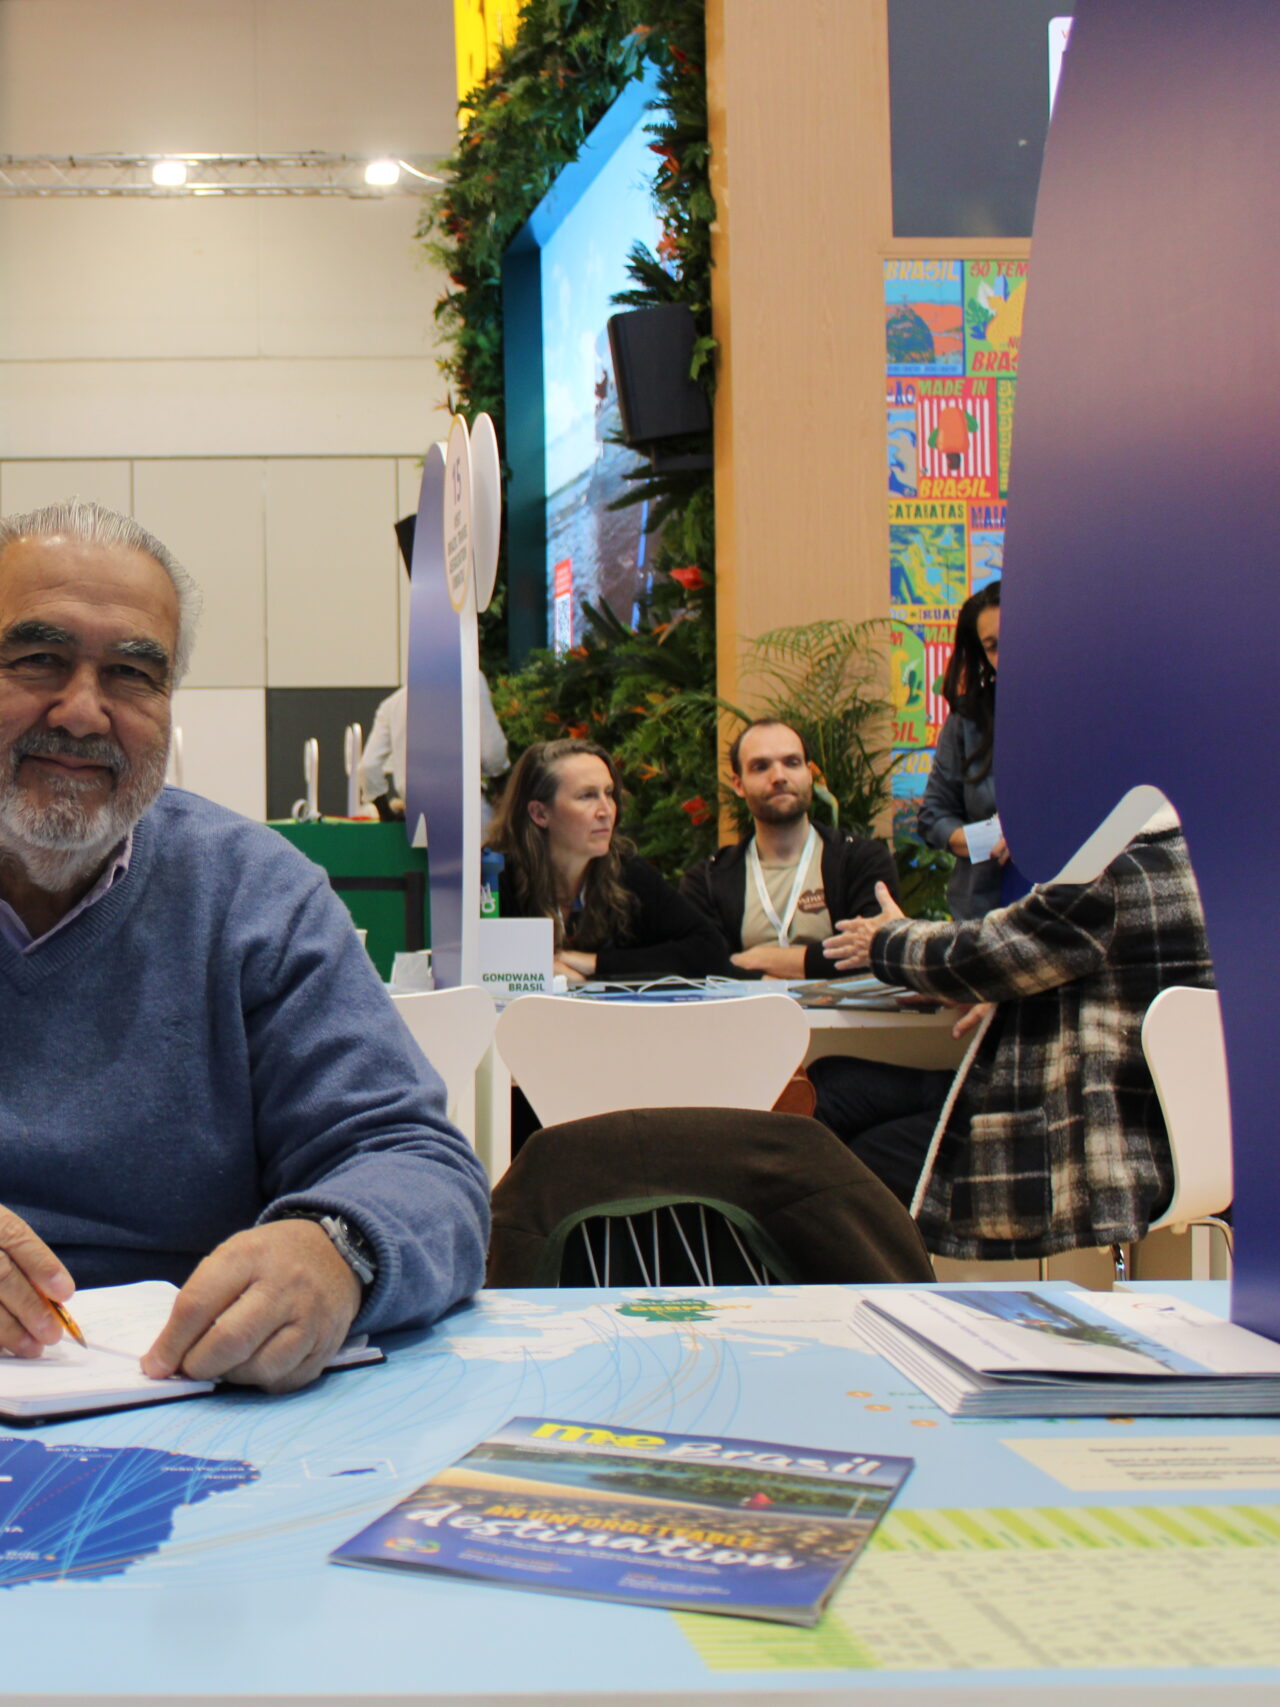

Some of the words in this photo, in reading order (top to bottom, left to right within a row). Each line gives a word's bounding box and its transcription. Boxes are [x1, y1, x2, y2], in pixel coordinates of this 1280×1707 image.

[886, 260, 959, 281] BRASIL
[918, 379, 966, 396] MADE
[972, 380, 989, 396] IN
[921, 478, 991, 498] BRASIL
[482, 973, 545, 983] GONDWANA
[508, 983, 545, 992] BRASIL
[668, 1441, 884, 1478] Brasil
[406, 1503, 806, 1571] destination
